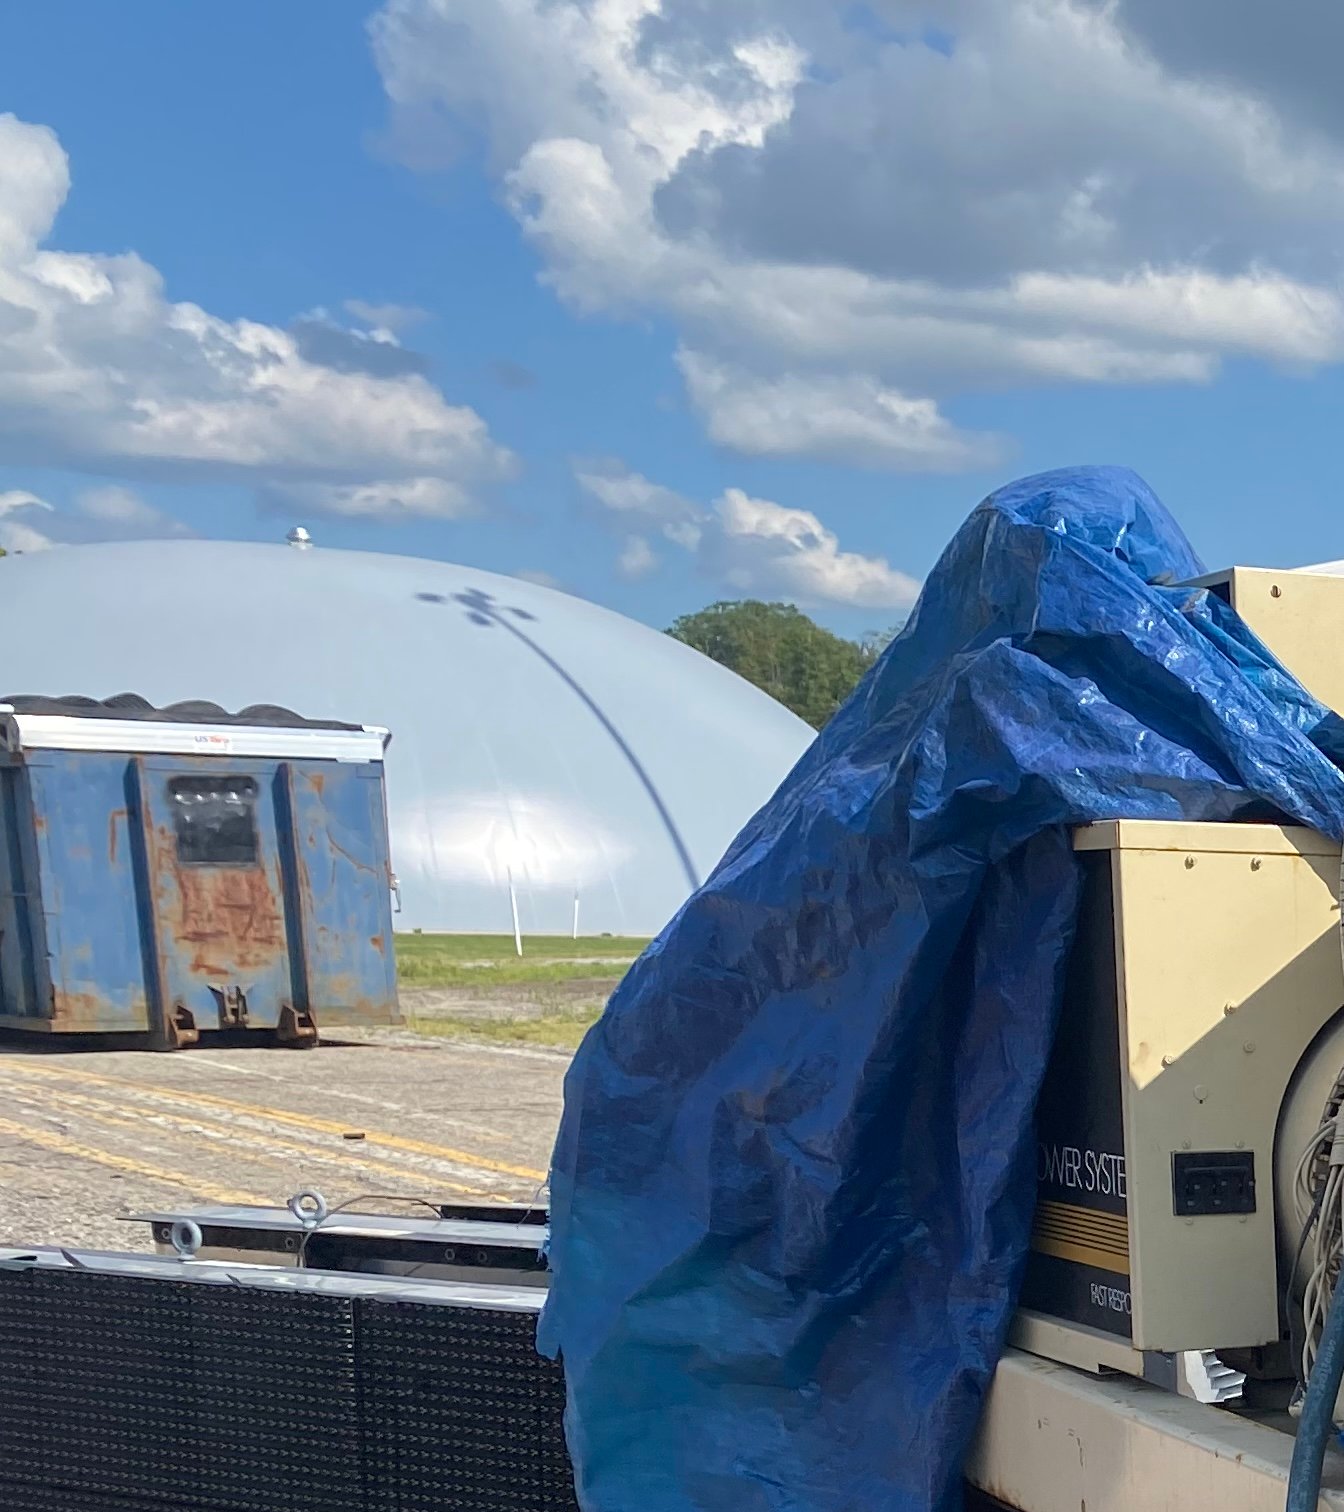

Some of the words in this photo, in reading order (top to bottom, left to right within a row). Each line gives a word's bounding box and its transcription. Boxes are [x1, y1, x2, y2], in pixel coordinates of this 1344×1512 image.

[1037, 1143, 1083, 1190] OWER
[1085, 1150, 1126, 1198] SYSTE
[1108, 1288, 1132, 1315] RESPO
